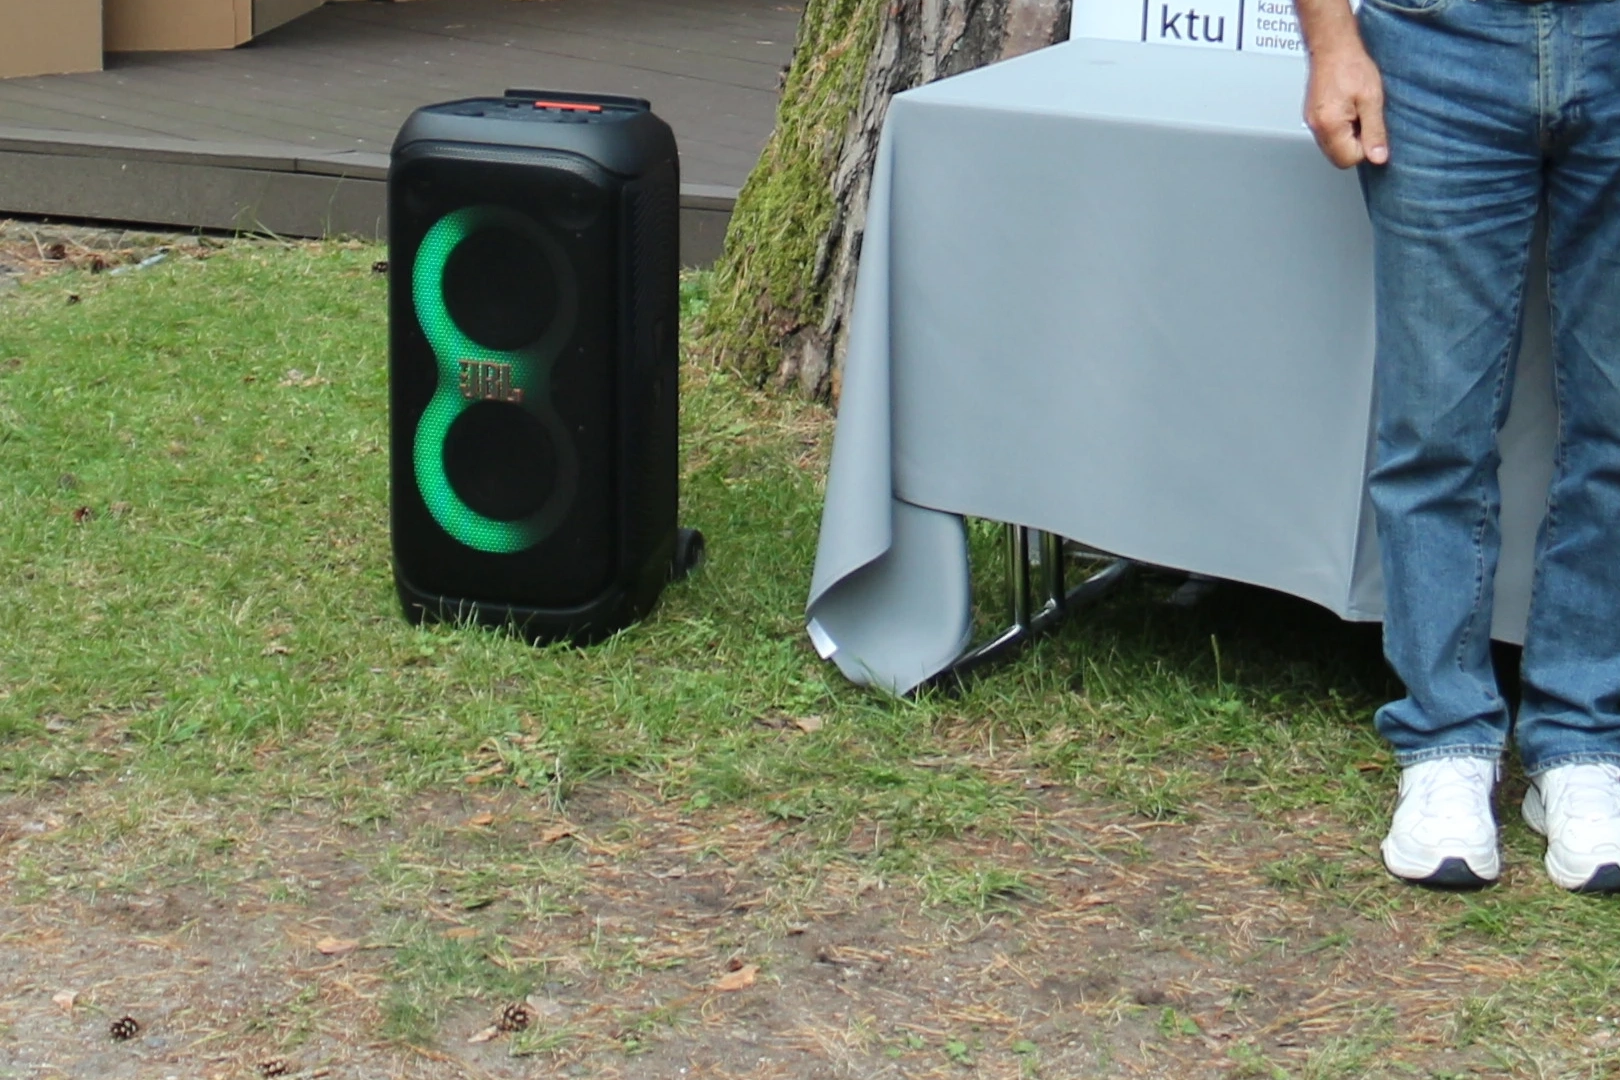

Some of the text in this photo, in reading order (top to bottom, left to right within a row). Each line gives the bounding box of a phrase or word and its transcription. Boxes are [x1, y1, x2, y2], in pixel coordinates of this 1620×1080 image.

[1257, 0, 1296, 16] kaun
[1160, 3, 1225, 44] ktu
[1256, 17, 1301, 33] techn
[1255, 34, 1305, 51] univer
[458, 359, 523, 402] JBL
